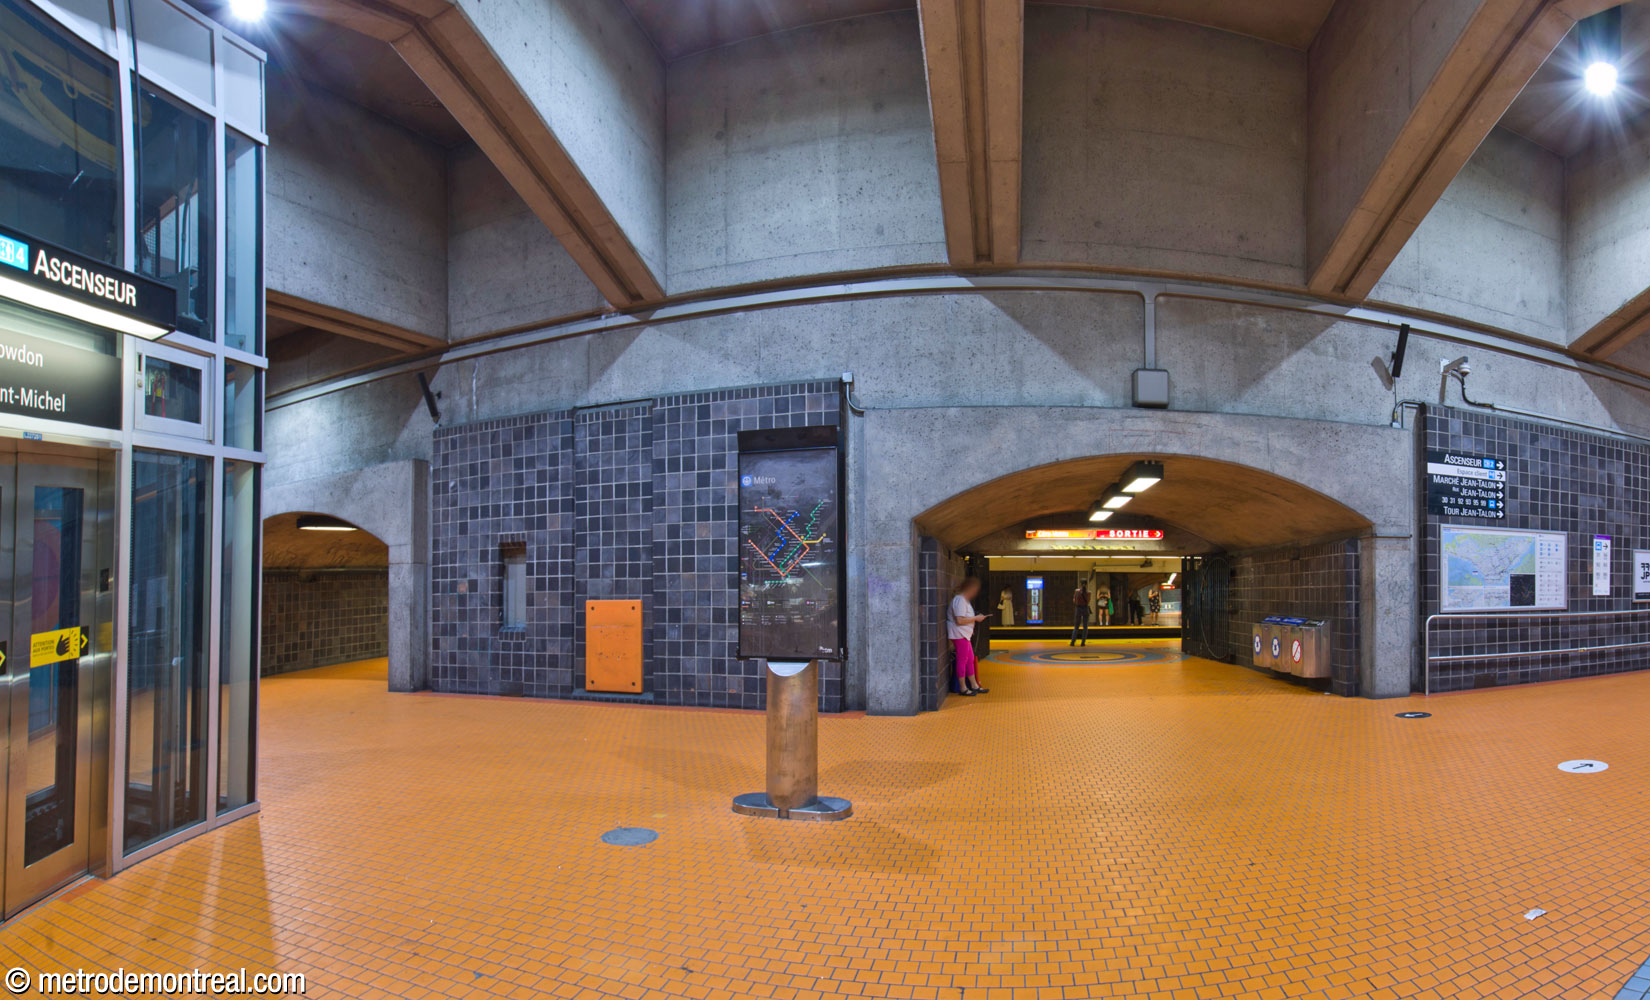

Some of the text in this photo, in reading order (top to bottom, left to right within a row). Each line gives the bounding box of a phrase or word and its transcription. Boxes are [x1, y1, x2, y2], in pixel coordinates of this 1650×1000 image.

[33, 249, 137, 307] ASCENSEUR
[0, 386, 66, 412] nt-Michel
[1444, 454, 1482, 467] ASCENSEUR
[1457, 468, 1488, 477] Espace client
[754, 475, 776, 485] Métro
[1433, 475, 1496, 489] MARCHÉ JEAN-TALON
[1460, 488, 1496, 498] JEAN-TALON
[1443, 506, 1496, 518] TOUR JEAN-TALON
